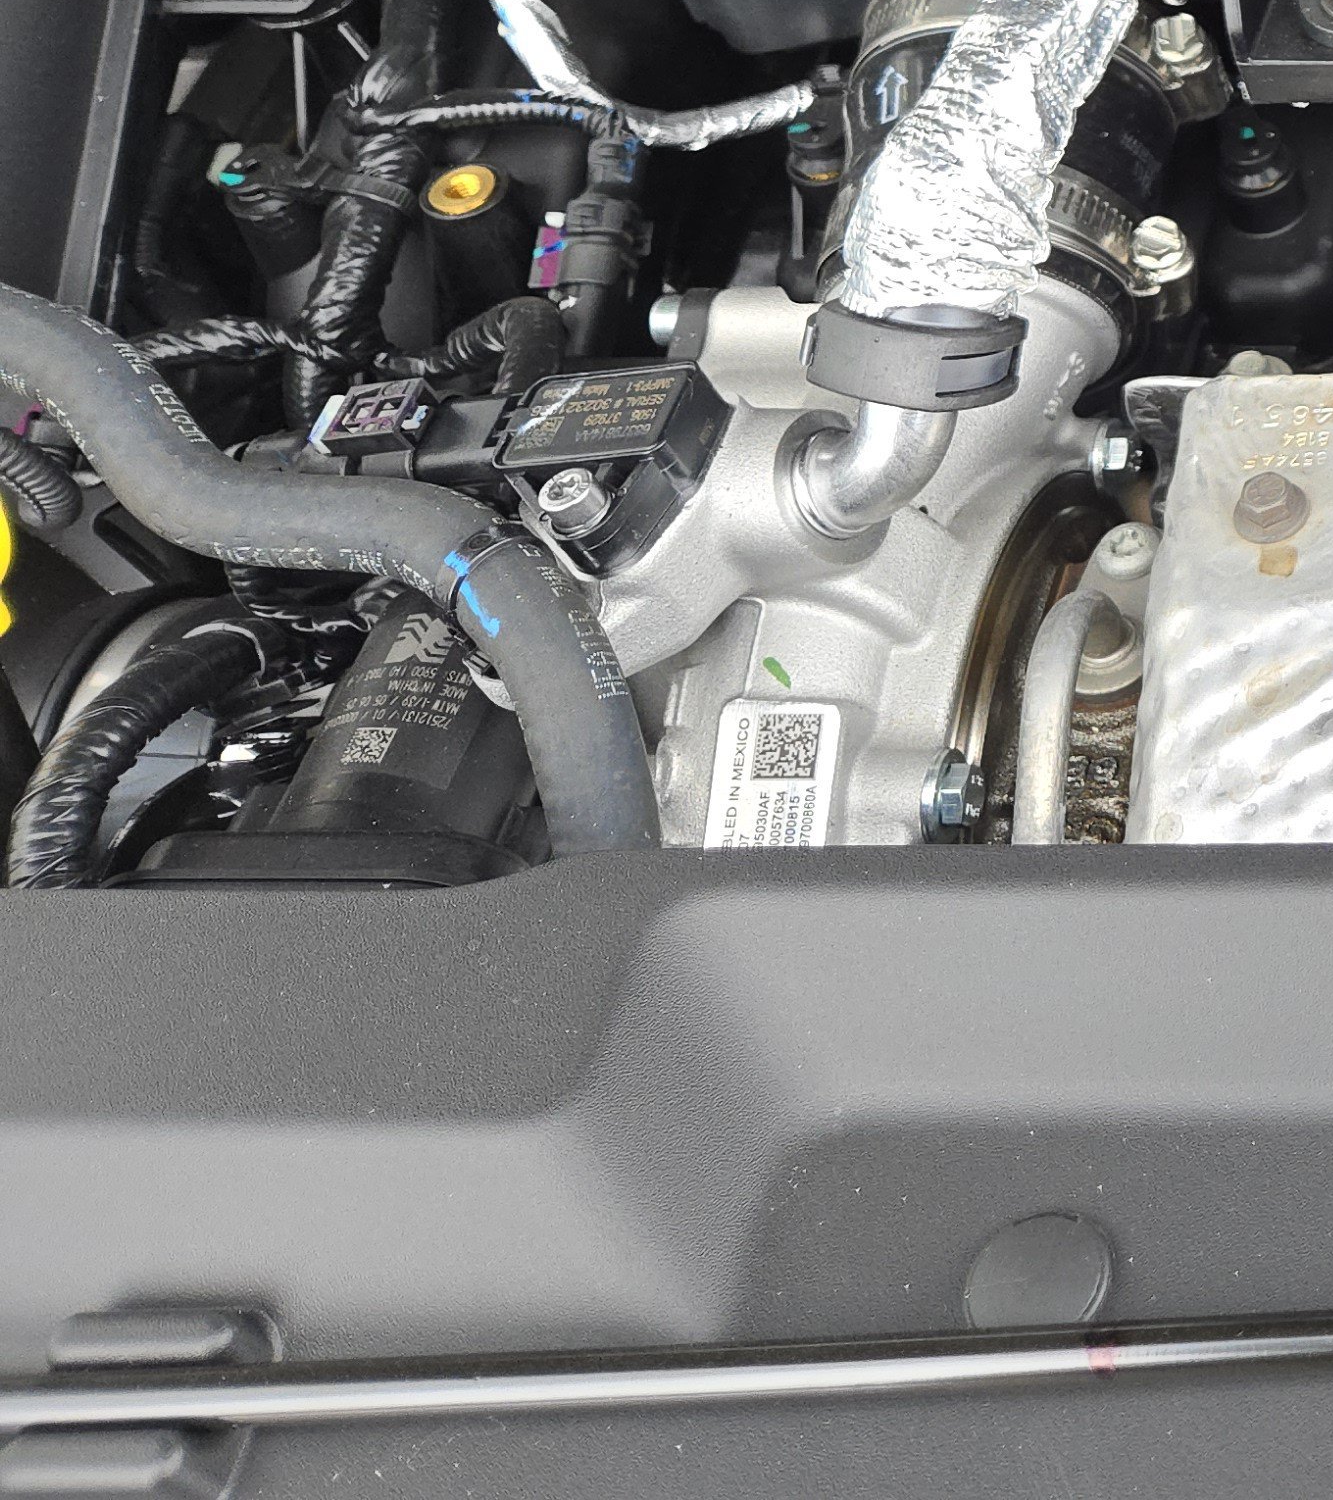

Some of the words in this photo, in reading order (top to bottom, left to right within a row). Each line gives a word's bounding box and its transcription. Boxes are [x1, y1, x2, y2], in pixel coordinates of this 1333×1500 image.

[422, 682, 436, 694] IN
[439, 684, 469, 702] MADE
[732, 717, 750, 781] MEXICO
[729, 786, 741, 801] IN
